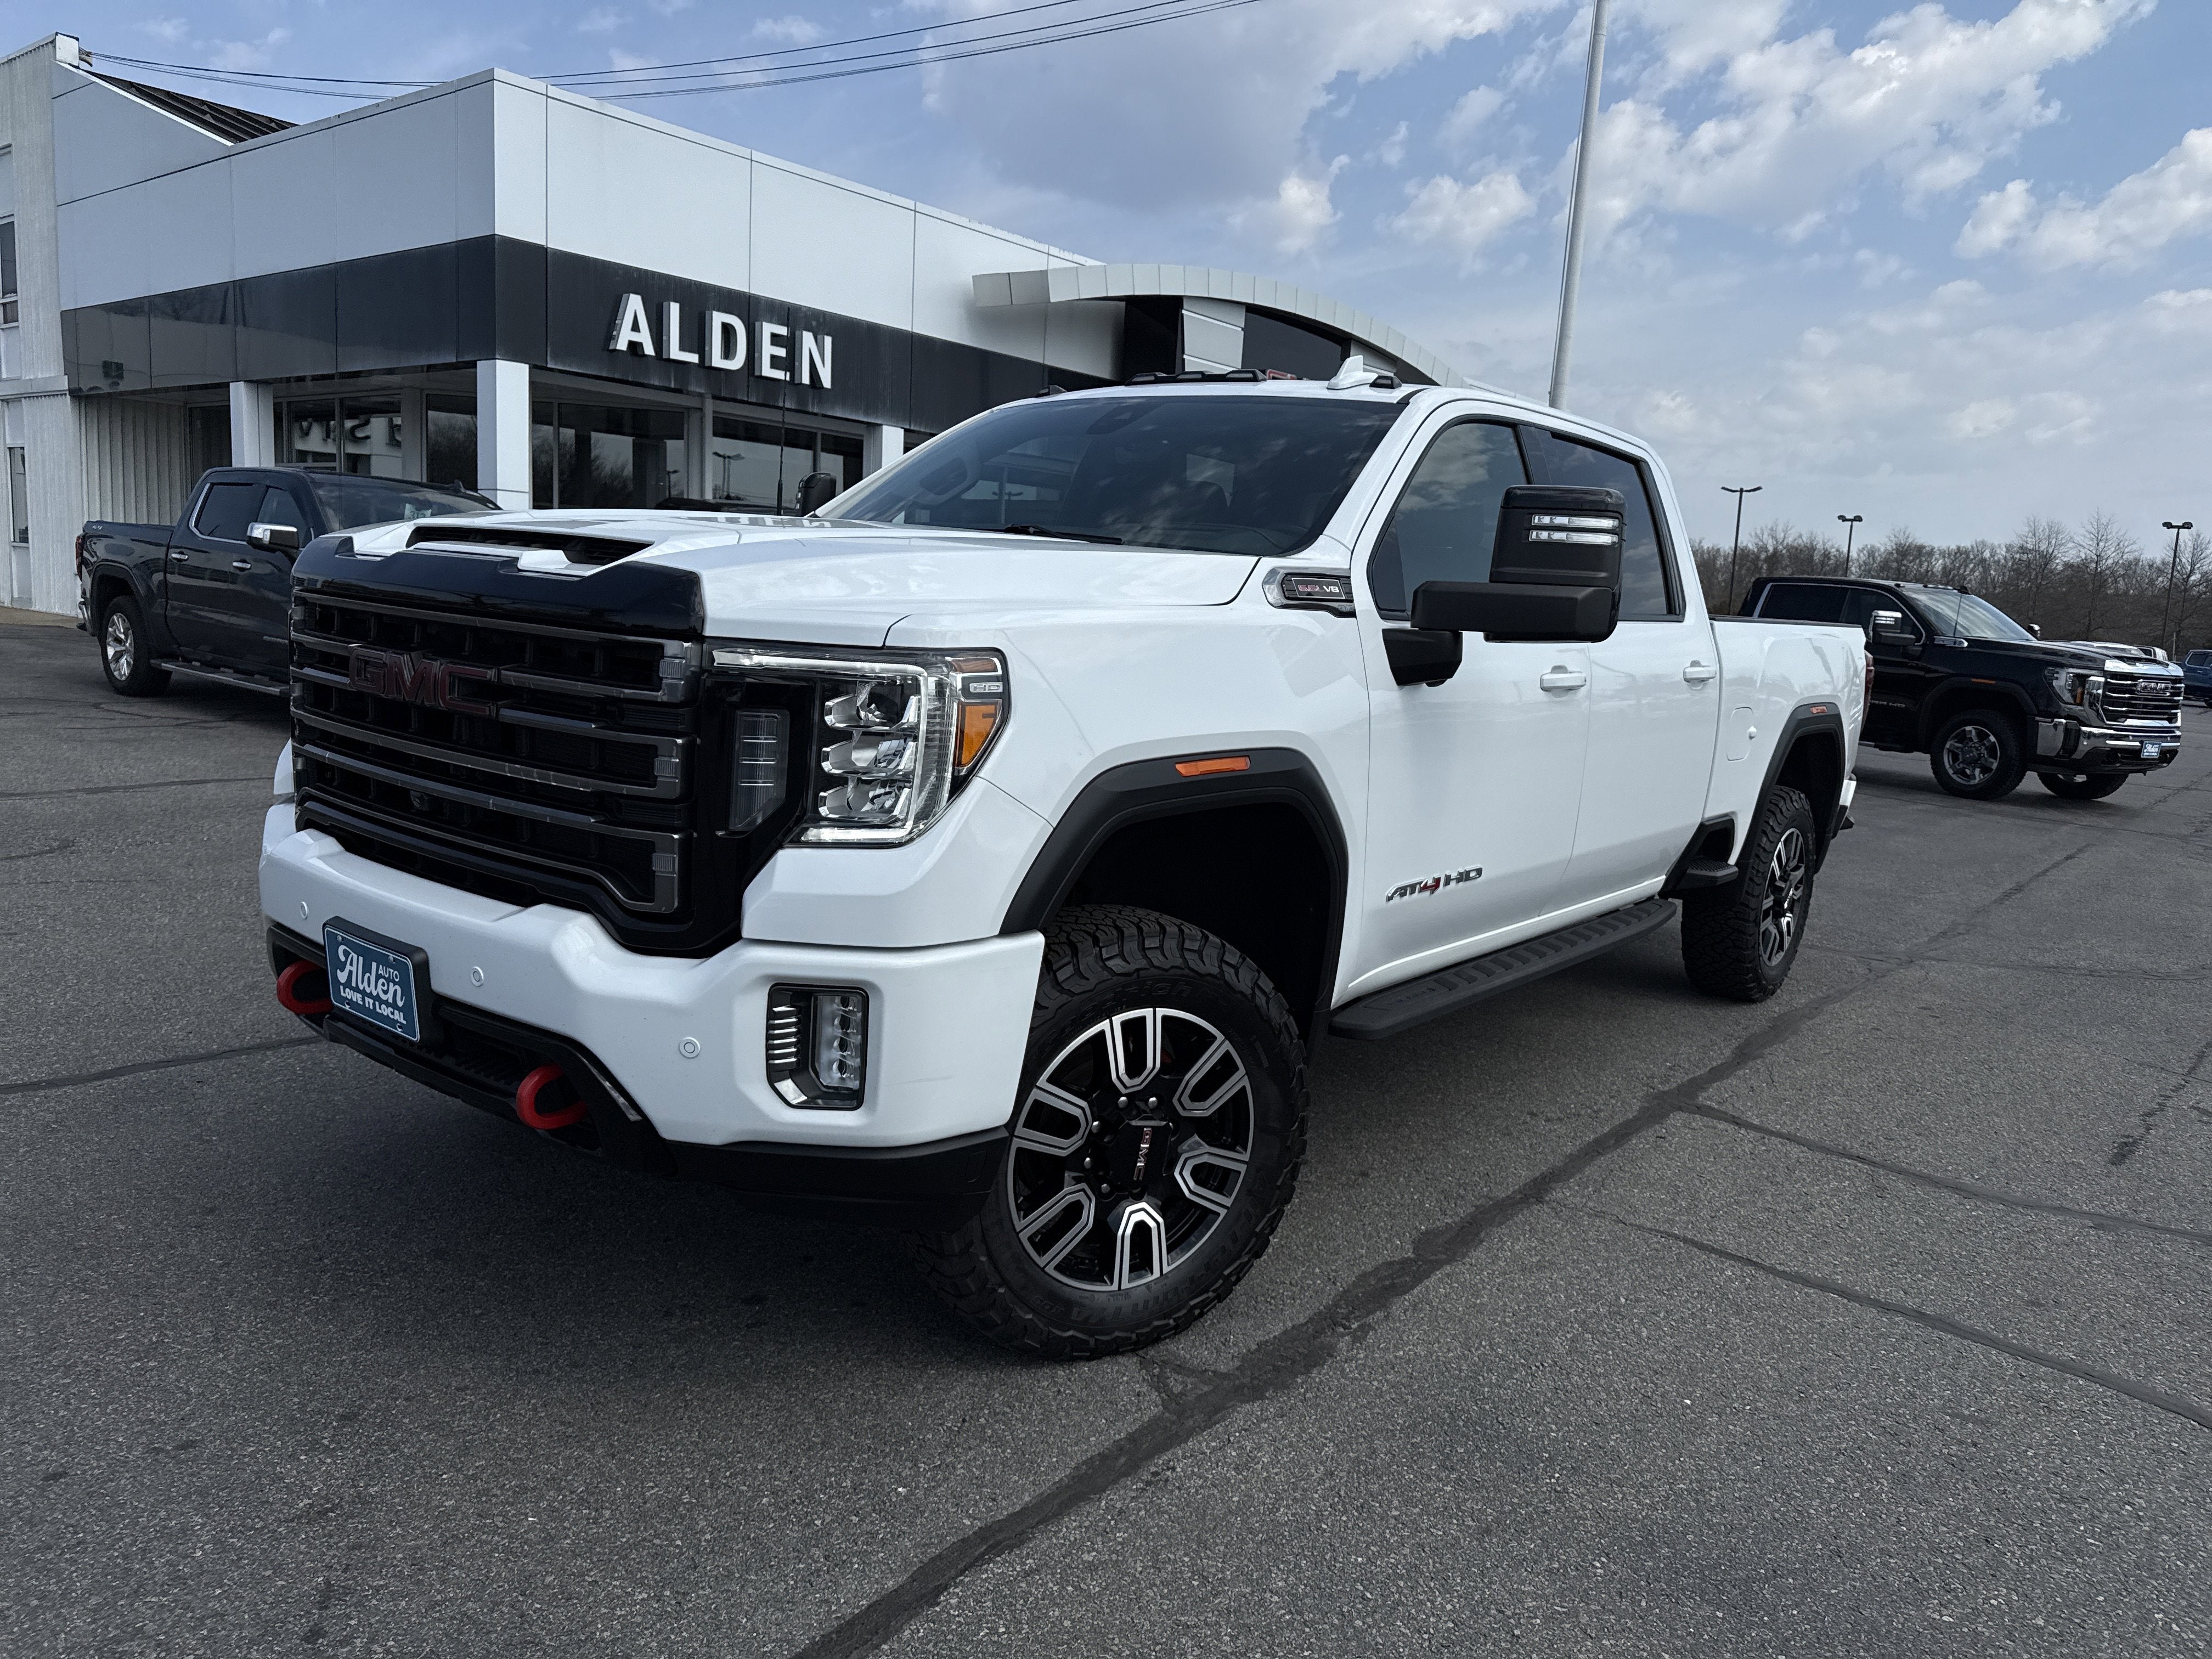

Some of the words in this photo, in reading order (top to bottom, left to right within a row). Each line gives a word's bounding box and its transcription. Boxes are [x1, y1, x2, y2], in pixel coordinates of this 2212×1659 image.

[608, 292, 832, 389] ALDEN
[349, 645, 495, 715] GMC
[1385, 874, 1441, 902] AT4
[1443, 865, 1483, 887] HD
[337, 945, 405, 1007] Alden
[378, 964, 400, 982] AUTO
[340, 985, 363, 1005] LOVE
[365, 996, 374, 1009] IT
[376, 1000, 407, 1024] LOCAL
[1133, 1127, 1152, 1180] GMC
